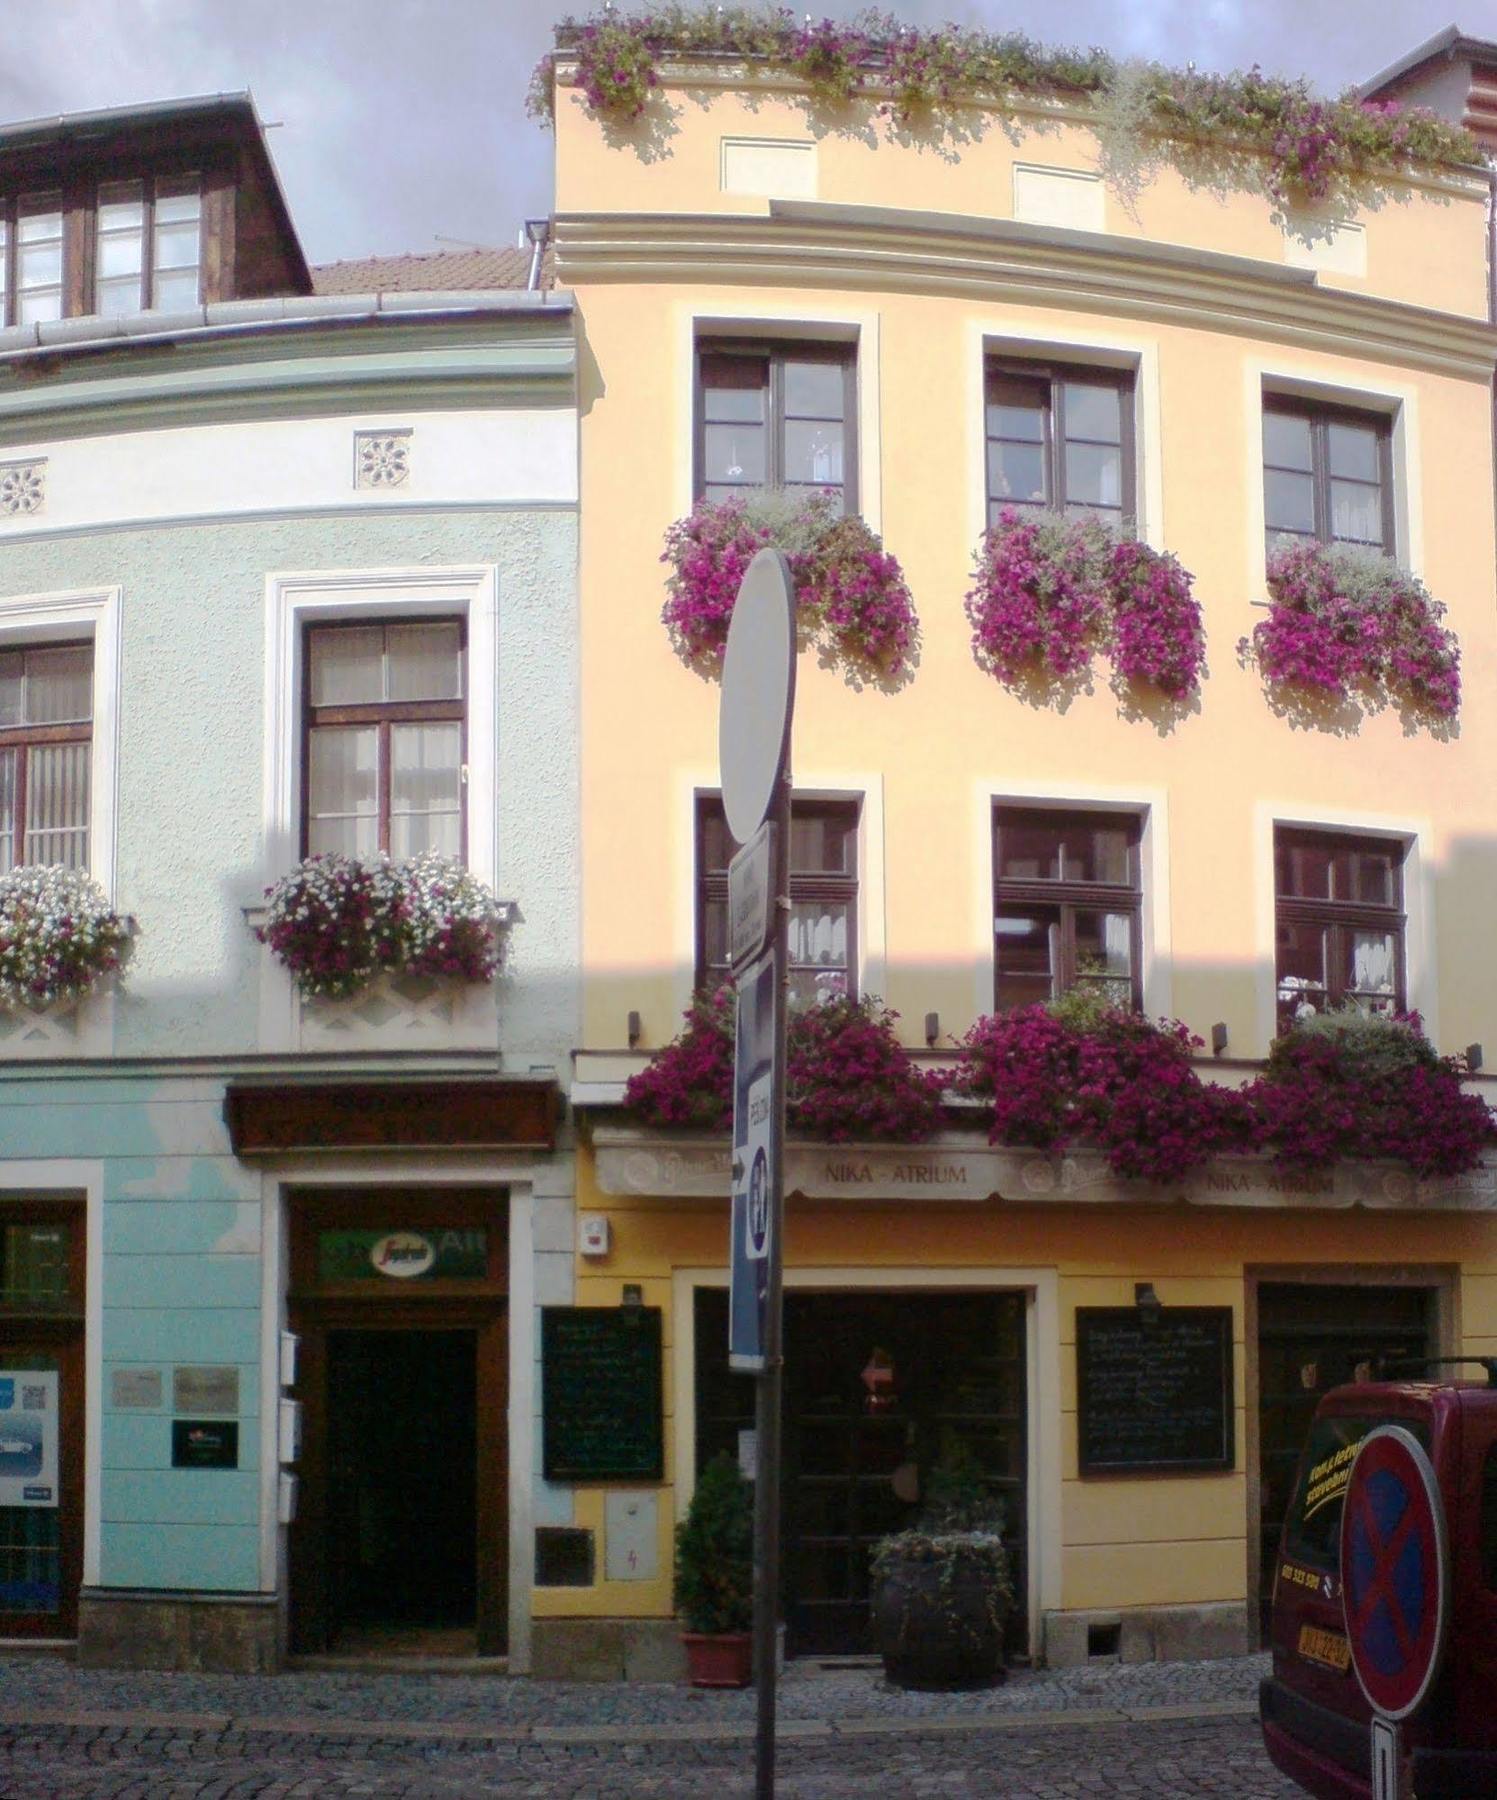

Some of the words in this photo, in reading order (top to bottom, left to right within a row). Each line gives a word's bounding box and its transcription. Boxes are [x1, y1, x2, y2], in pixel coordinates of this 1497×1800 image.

[826, 1164, 873, 1183] NIKA
[893, 1165, 967, 1184] ATRIUM
[1208, 1174, 1250, 1191] NIKA
[1268, 1175, 1334, 1193] ATRIUM
